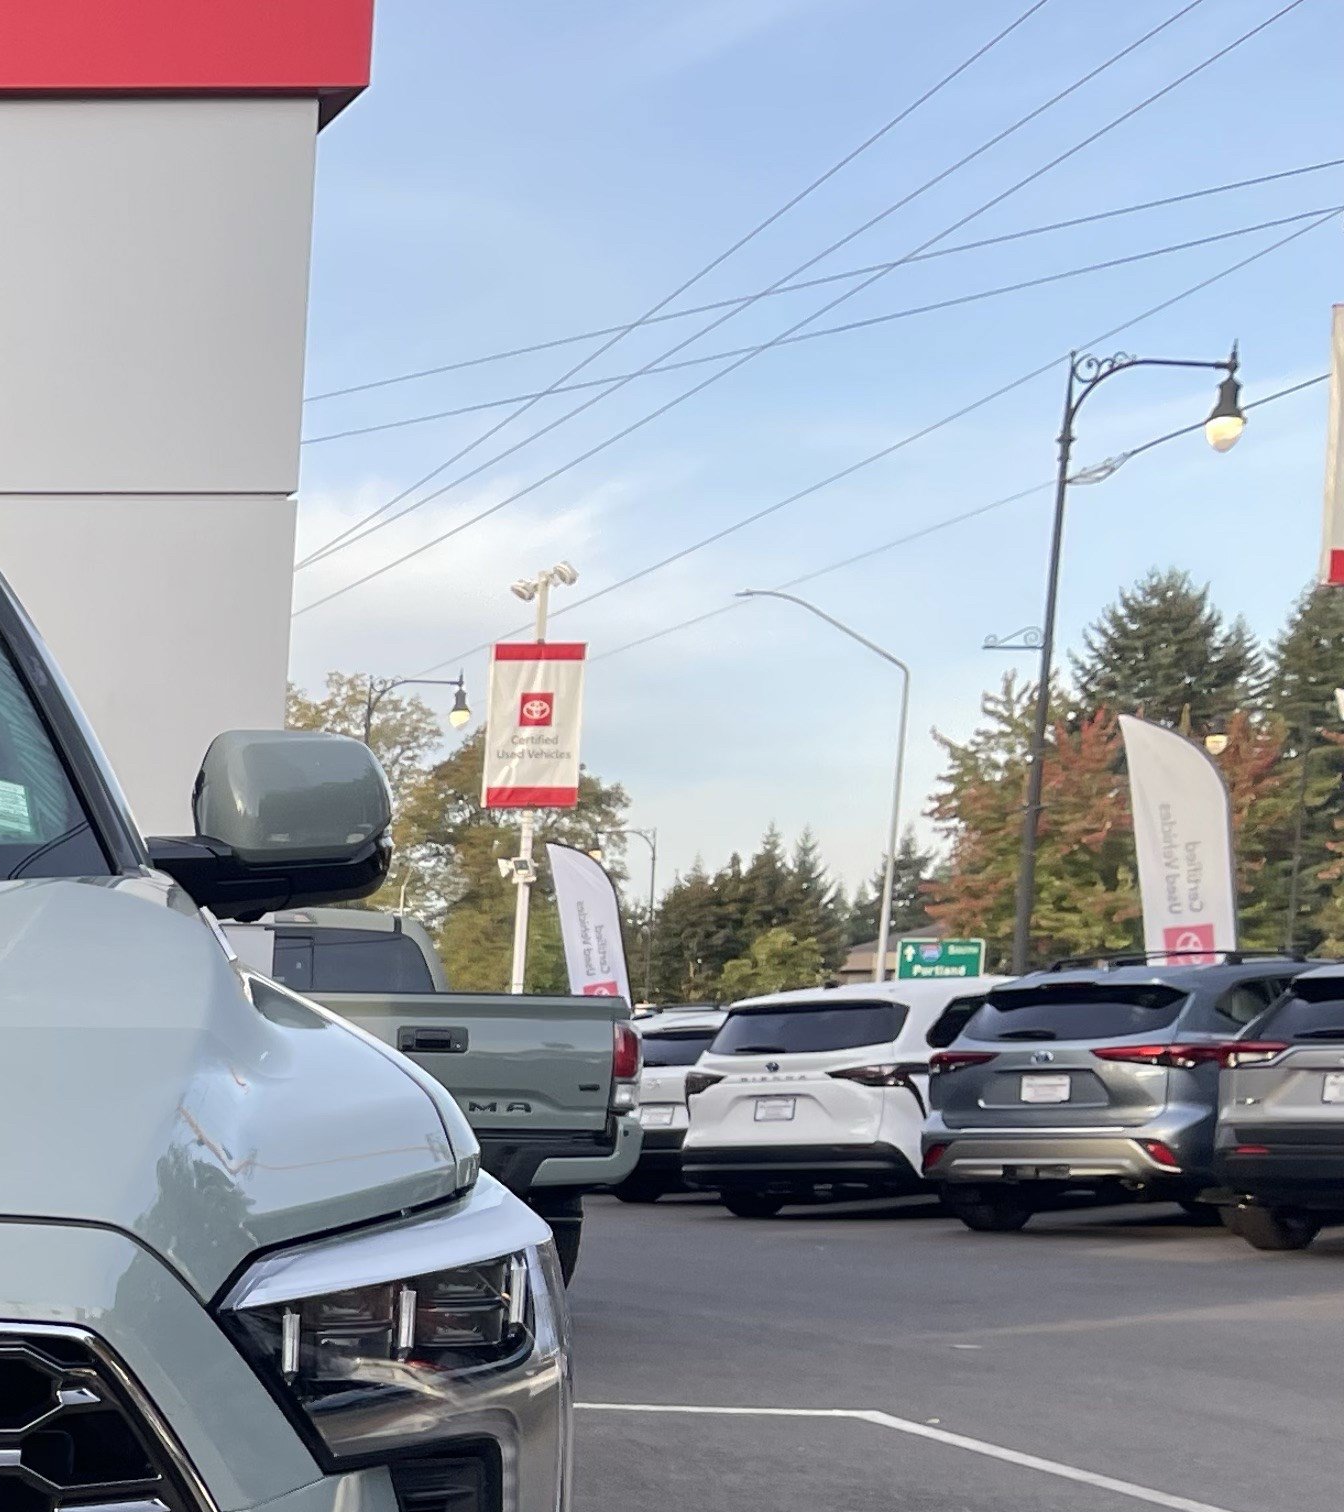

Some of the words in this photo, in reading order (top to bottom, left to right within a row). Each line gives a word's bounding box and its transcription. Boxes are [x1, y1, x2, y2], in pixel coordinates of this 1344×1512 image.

[511, 735, 559, 746] Certified
[496, 749, 525, 760] Used
[528, 749, 572, 760] Vehicles
